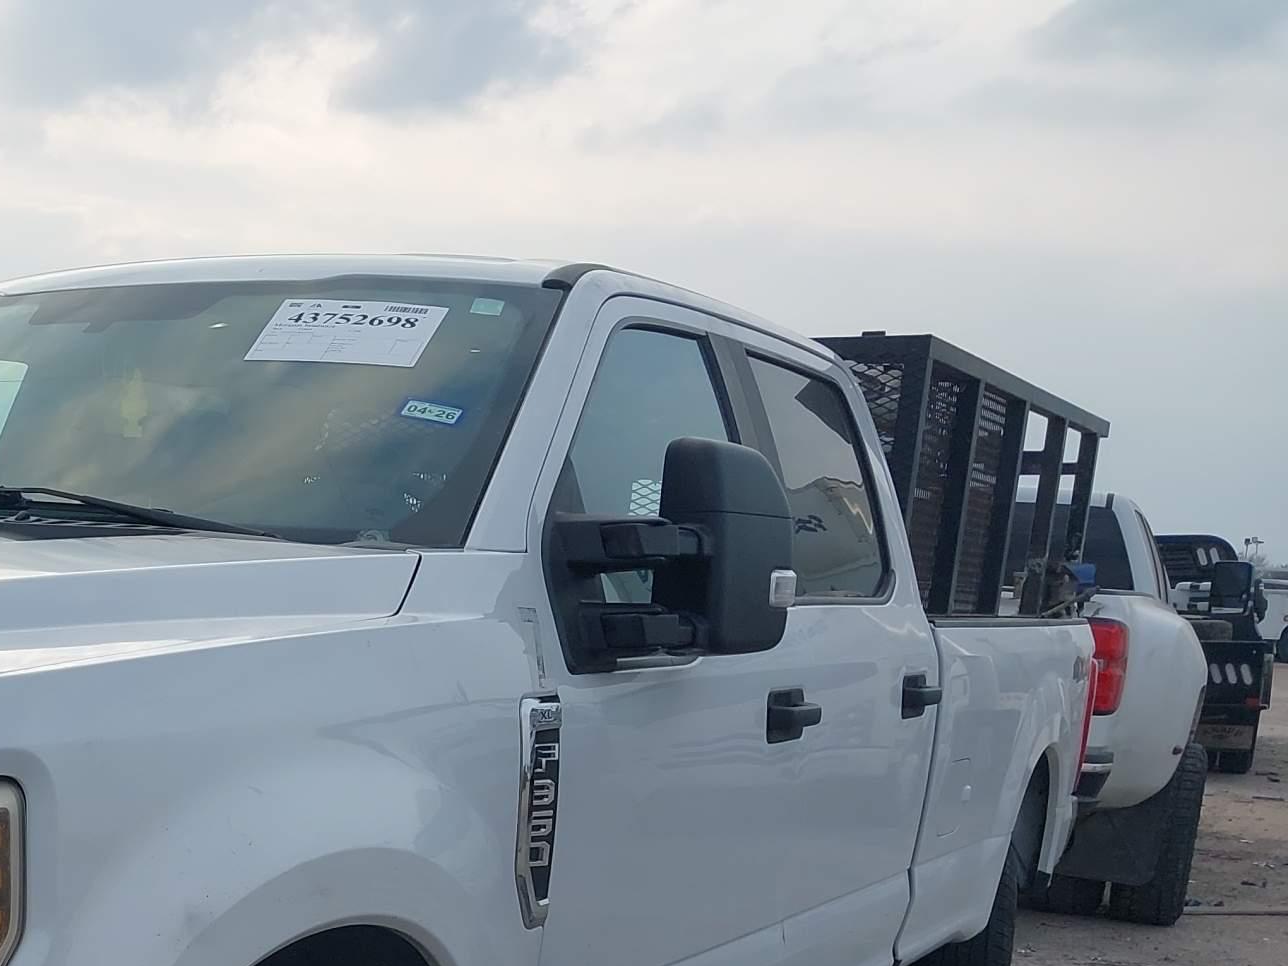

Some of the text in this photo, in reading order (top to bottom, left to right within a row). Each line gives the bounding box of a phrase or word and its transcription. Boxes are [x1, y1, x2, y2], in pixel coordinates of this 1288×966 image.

[287, 311, 420, 330] 43752698
[407, 404, 427, 415] 04
[434, 409, 457, 420] 26
